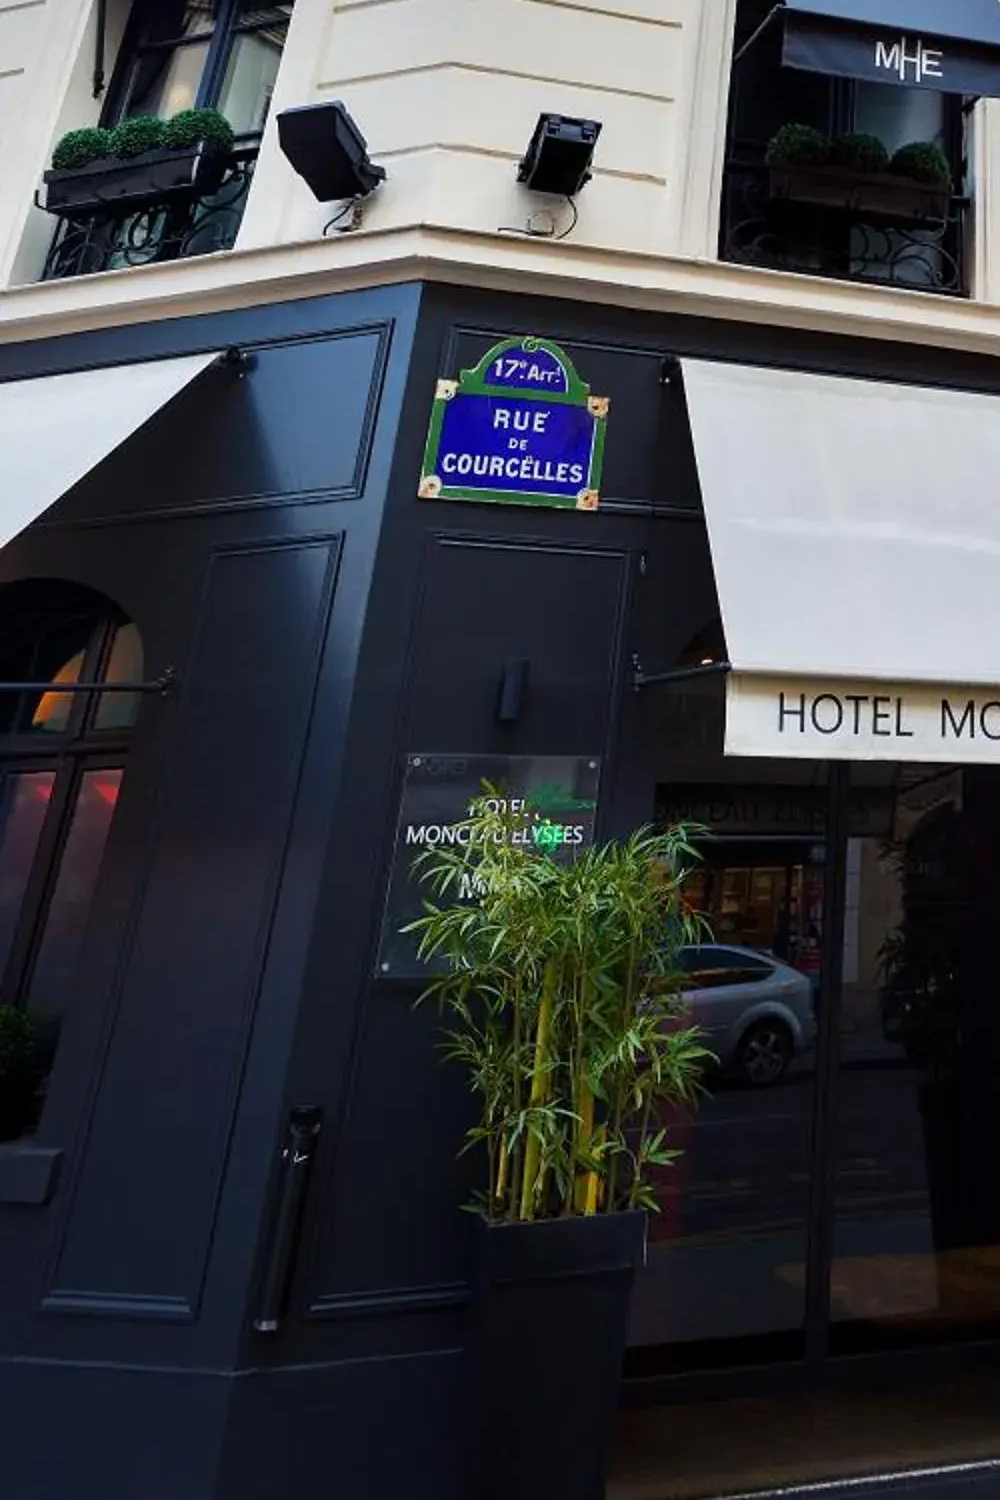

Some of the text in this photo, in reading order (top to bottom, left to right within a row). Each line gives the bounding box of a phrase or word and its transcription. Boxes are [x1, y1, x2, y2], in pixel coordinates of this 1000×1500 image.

[874, 35, 944, 83] MHE
[493, 408, 548, 434] RUE
[507, 437, 528, 451] DE
[442, 453, 584, 484] COURCELLES
[778, 691, 914, 737] HOTEL
